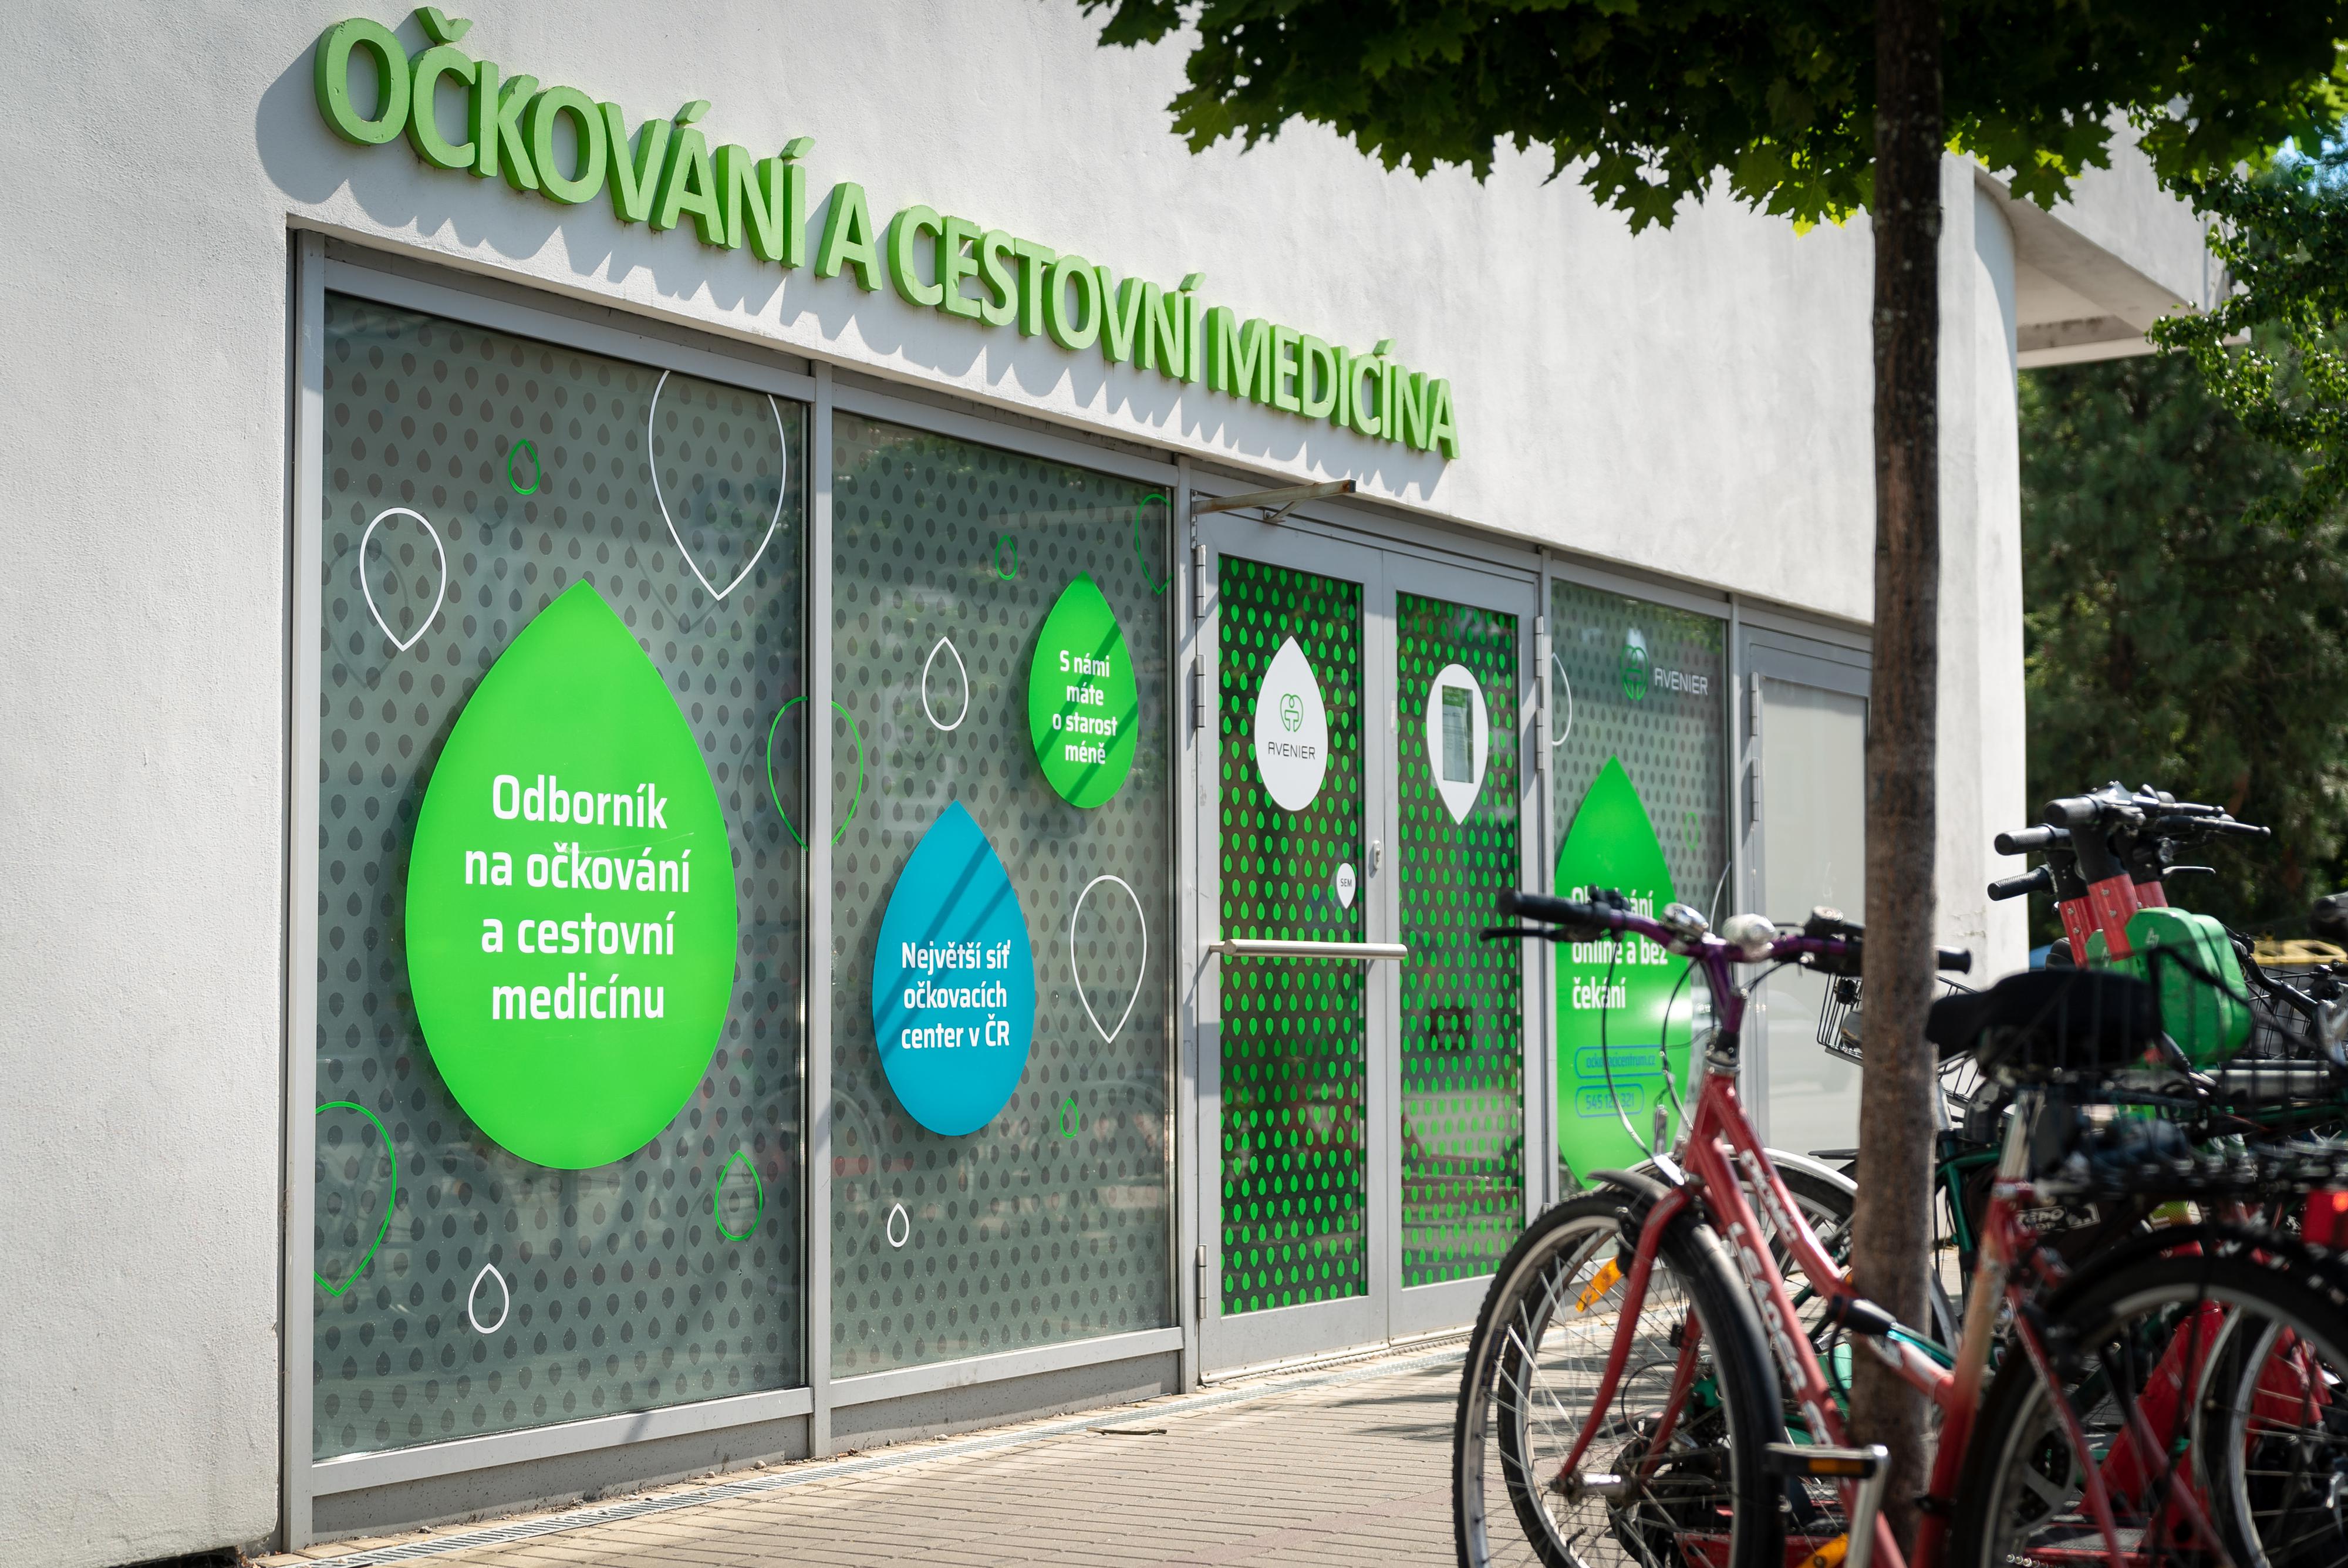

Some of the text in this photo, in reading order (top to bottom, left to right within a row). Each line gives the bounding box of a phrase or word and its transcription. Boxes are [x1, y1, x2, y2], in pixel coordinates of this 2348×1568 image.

[313, 6, 1460, 460] OČKOVÁNÍ A CESTOVNÍ MEDICÍNA
[1060, 650, 1110, 677] S námi
[1066, 682, 1104, 706] máte
[1655, 667, 1708, 695] AVENIER
[1052, 712, 1118, 736] o starost
[1065, 740, 1106, 764] méně
[1268, 741, 1315, 760] AVENIER
[492, 774, 667, 829] Odborník
[465, 842, 691, 892] na očkování
[1340, 878, 1352, 888] SEM
[481, 911, 676, 955] a cestovní
[902, 939, 1011, 976] Největší síť
[1627, 941, 1636, 964] a
[1641, 934, 1668, 965] bez
[492, 972, 664, 1020] medicínu
[903, 980, 1007, 1009] očkovacích
[1573, 976, 1626, 1009] čekání
[901, 1013, 1010, 1049] center v ČR
